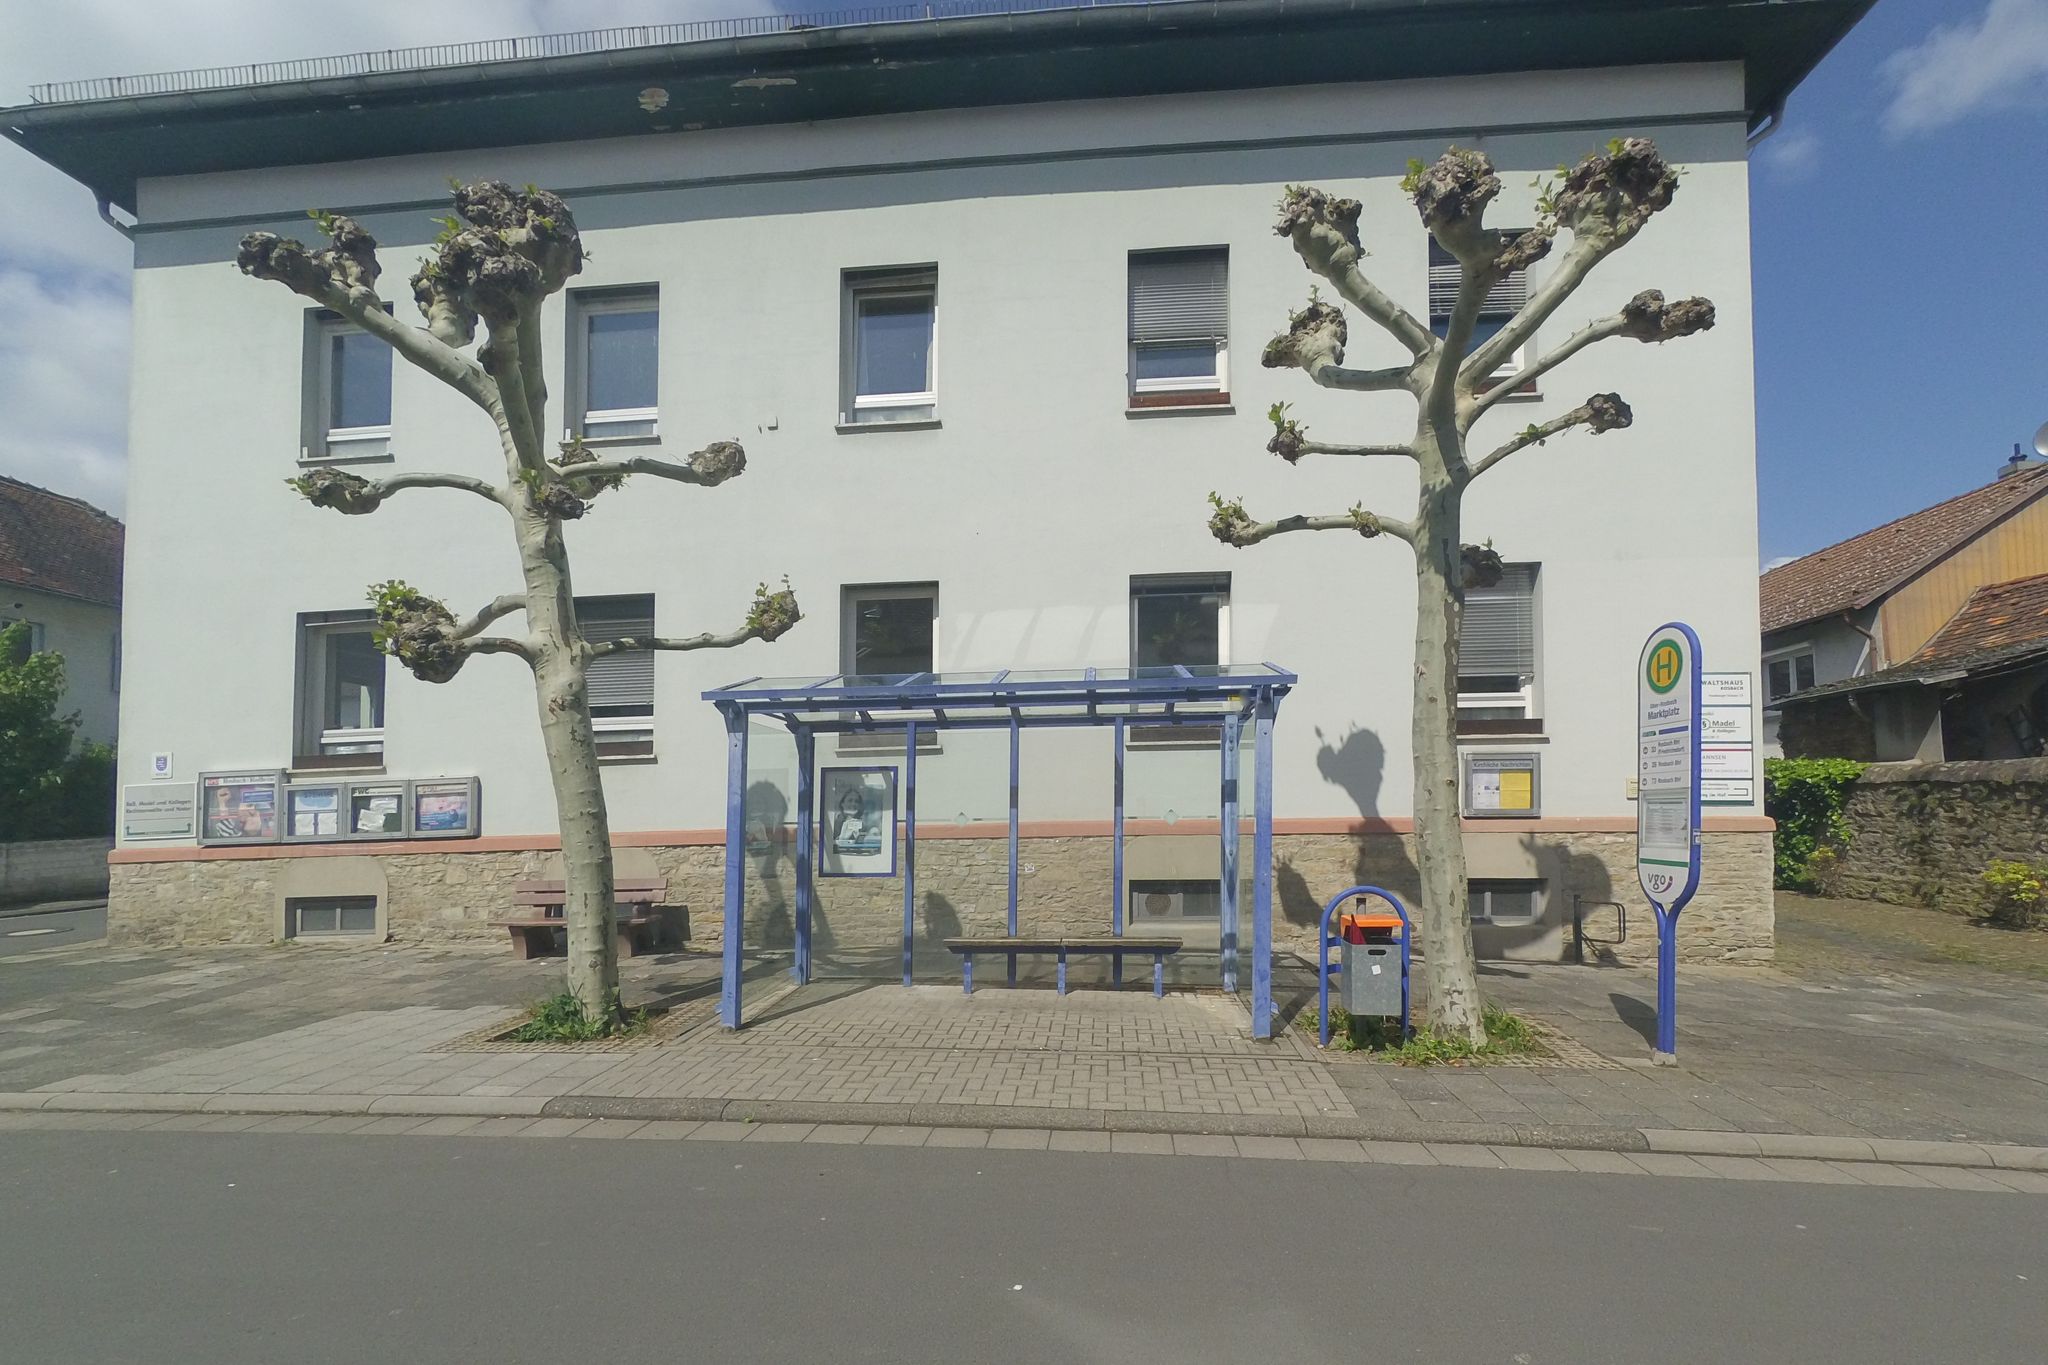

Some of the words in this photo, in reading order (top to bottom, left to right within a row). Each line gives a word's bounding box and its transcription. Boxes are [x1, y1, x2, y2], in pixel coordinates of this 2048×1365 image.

[1657, 650, 1672, 683] H
[1648, 707, 1680, 720] Marktplatz
[1474, 760, 1499, 768] Kirchliche
[1500, 760, 1532, 768] Nachrichten
[1648, 873, 1666, 890] vgo
